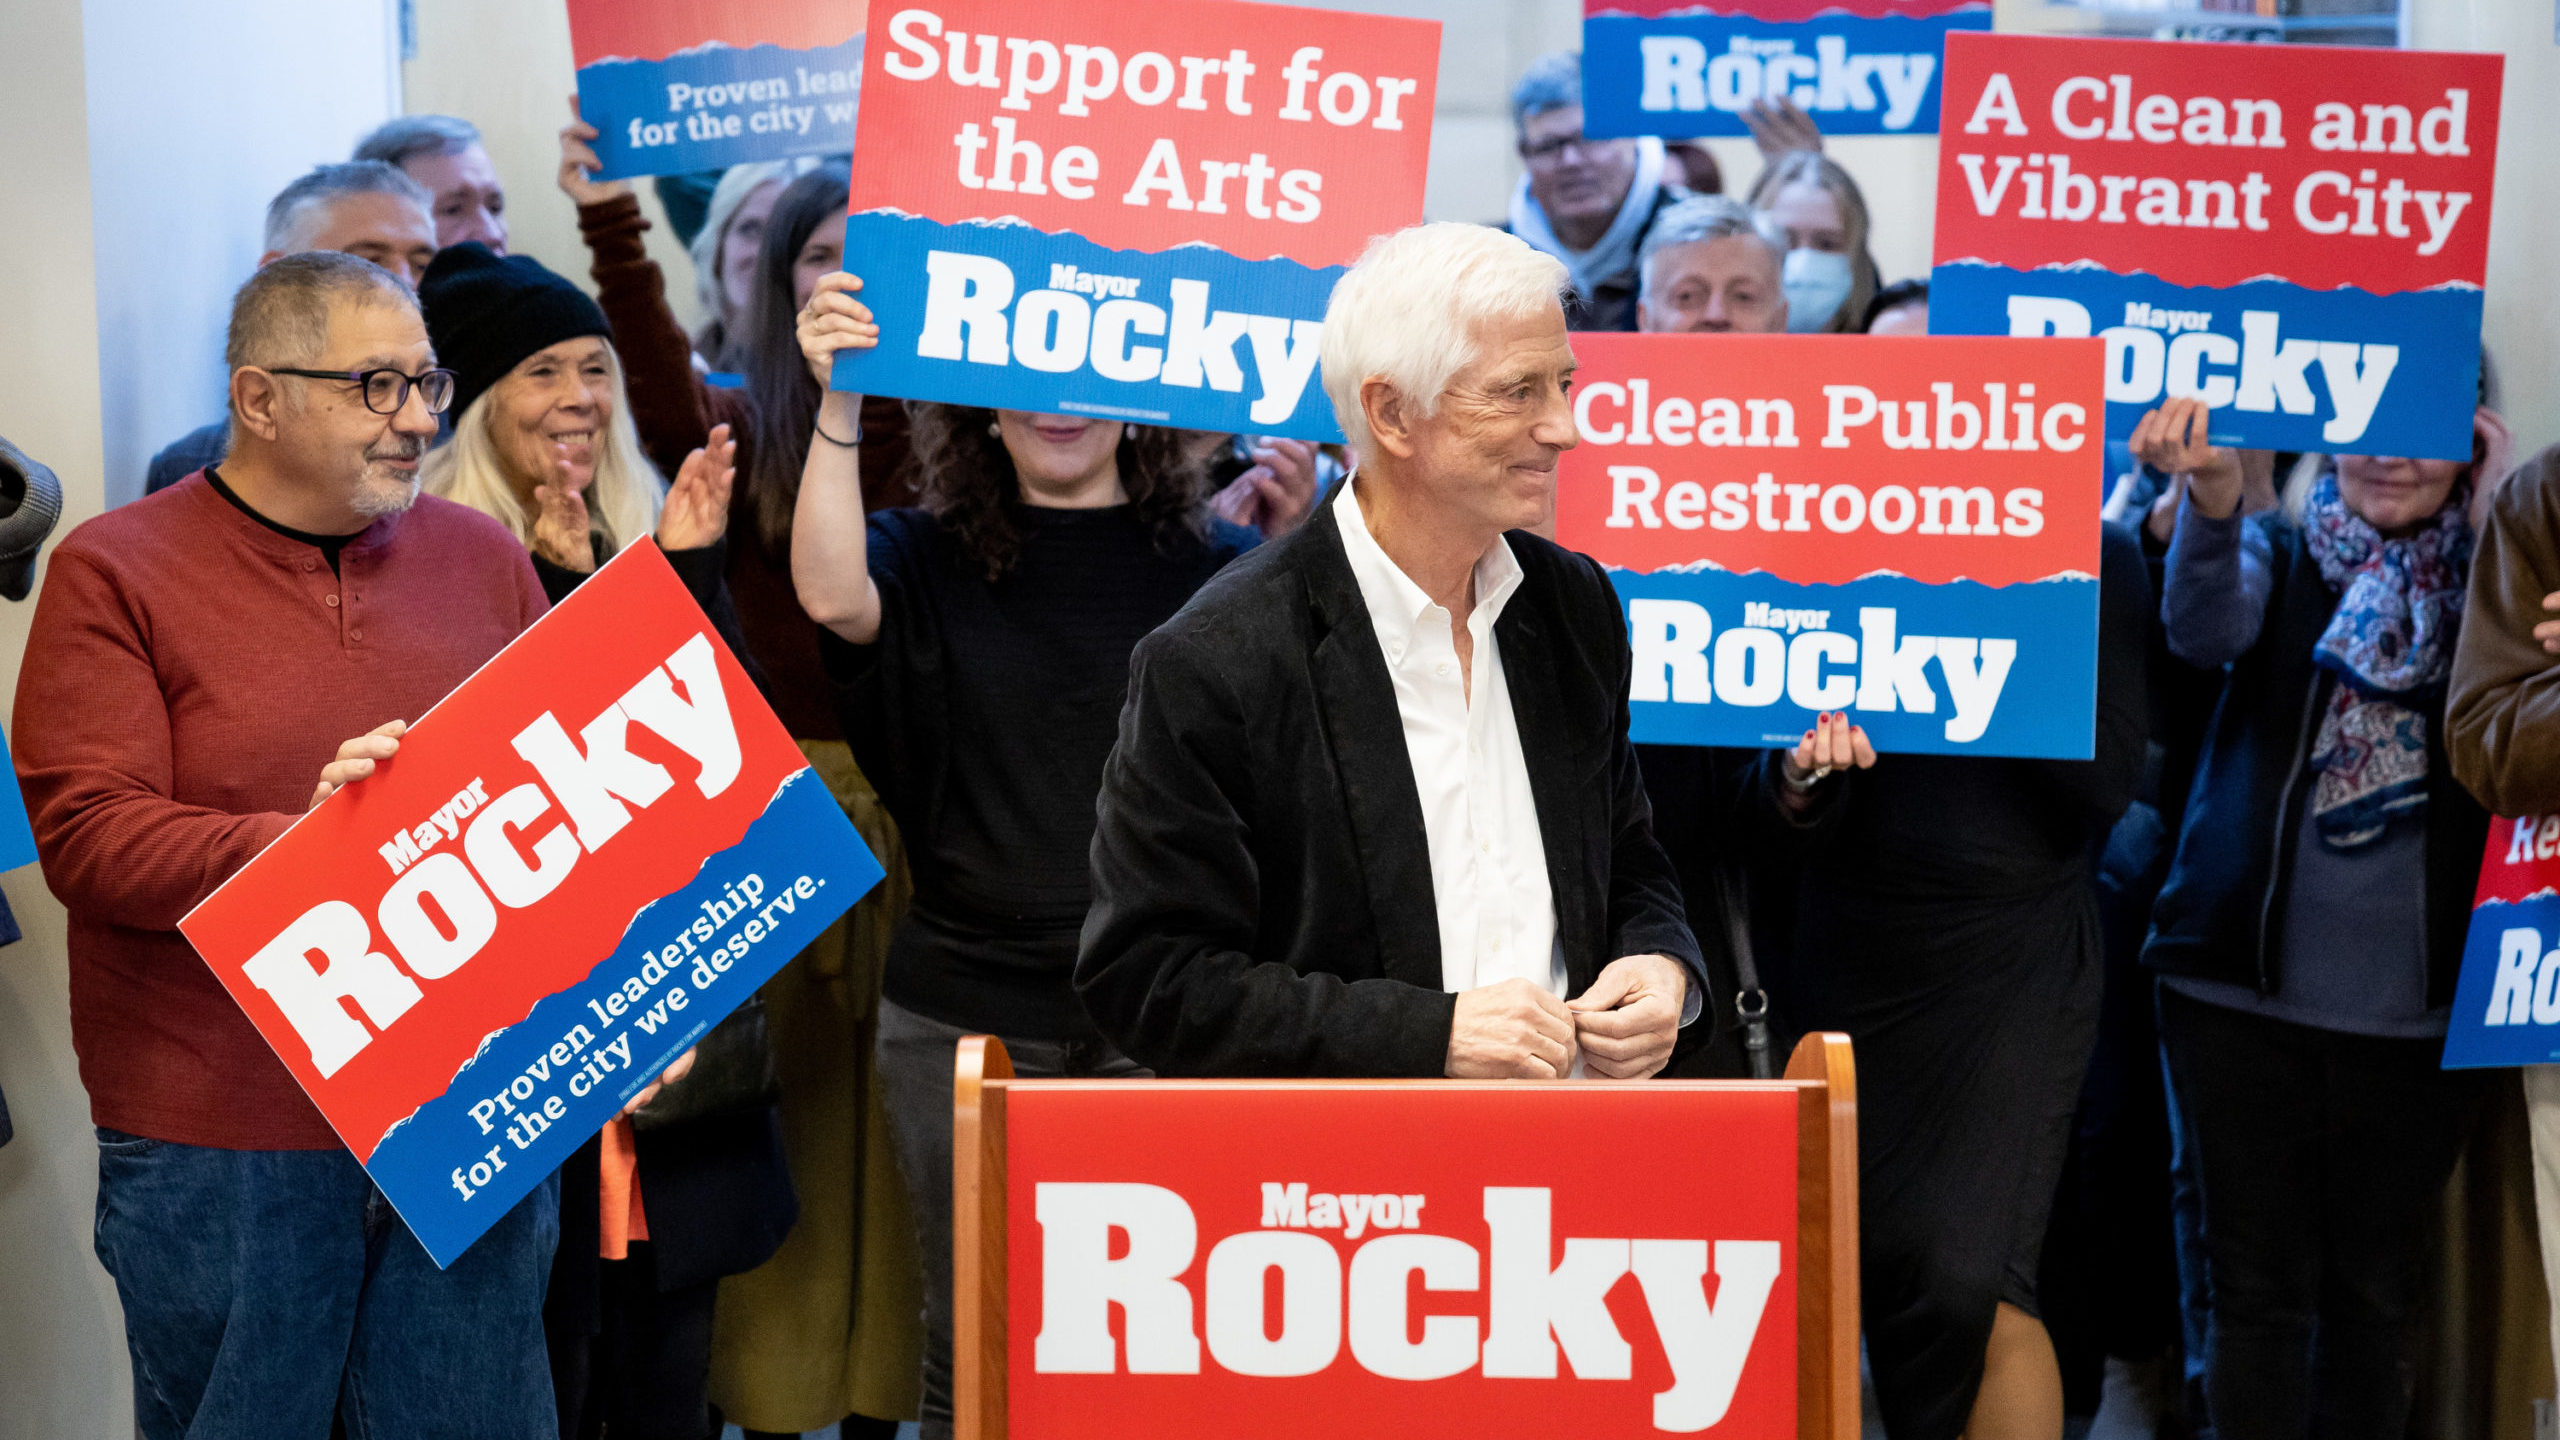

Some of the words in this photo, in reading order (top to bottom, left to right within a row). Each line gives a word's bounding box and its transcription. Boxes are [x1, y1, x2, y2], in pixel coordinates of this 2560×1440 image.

[668, 75, 790, 111] Proven
[885, 10, 1255, 117] Support
[1279, 47, 1416, 130] for
[1640, 36, 1934, 129] Rocky
[1966, 75, 2027, 134] A
[2053, 76, 2284, 146] Clean
[2311, 90, 2469, 154] and
[628, 117, 678, 148] for
[686, 110, 741, 141] the
[750, 102, 814, 134] city
[954, 110, 1099, 199] the
[1123, 139, 1322, 223] Arts
[1958, 154, 2271, 230] Vibrant
[2295, 170, 2470, 254] City
[1049, 264, 1140, 300] Mayor
[2124, 303, 2212, 334] Mayor
[917, 250, 1323, 425] Rocky
[1573, 379, 1798, 446] Clean
[1822, 383, 2085, 451] Public
[1606, 466, 2043, 536] Restrooms
[1744, 602, 1830, 635] Mayor
[1629, 600, 2016, 741] Rocky
[242, 632, 741, 1079] Rocky
[379, 777, 489, 875] Mayor
[452, 1145, 506, 1201] for
[507, 1096, 566, 1149] the
[570, 1032, 631, 1096] city
[635, 988, 688, 1034] we
[692, 876, 825, 989] deserve.
[468, 1025, 595, 1135] Proven
[588, 874, 763, 1028] leadership
[1261, 1183, 1425, 1239] Mayor
[1036, 1183, 1779, 1431] Rocky
